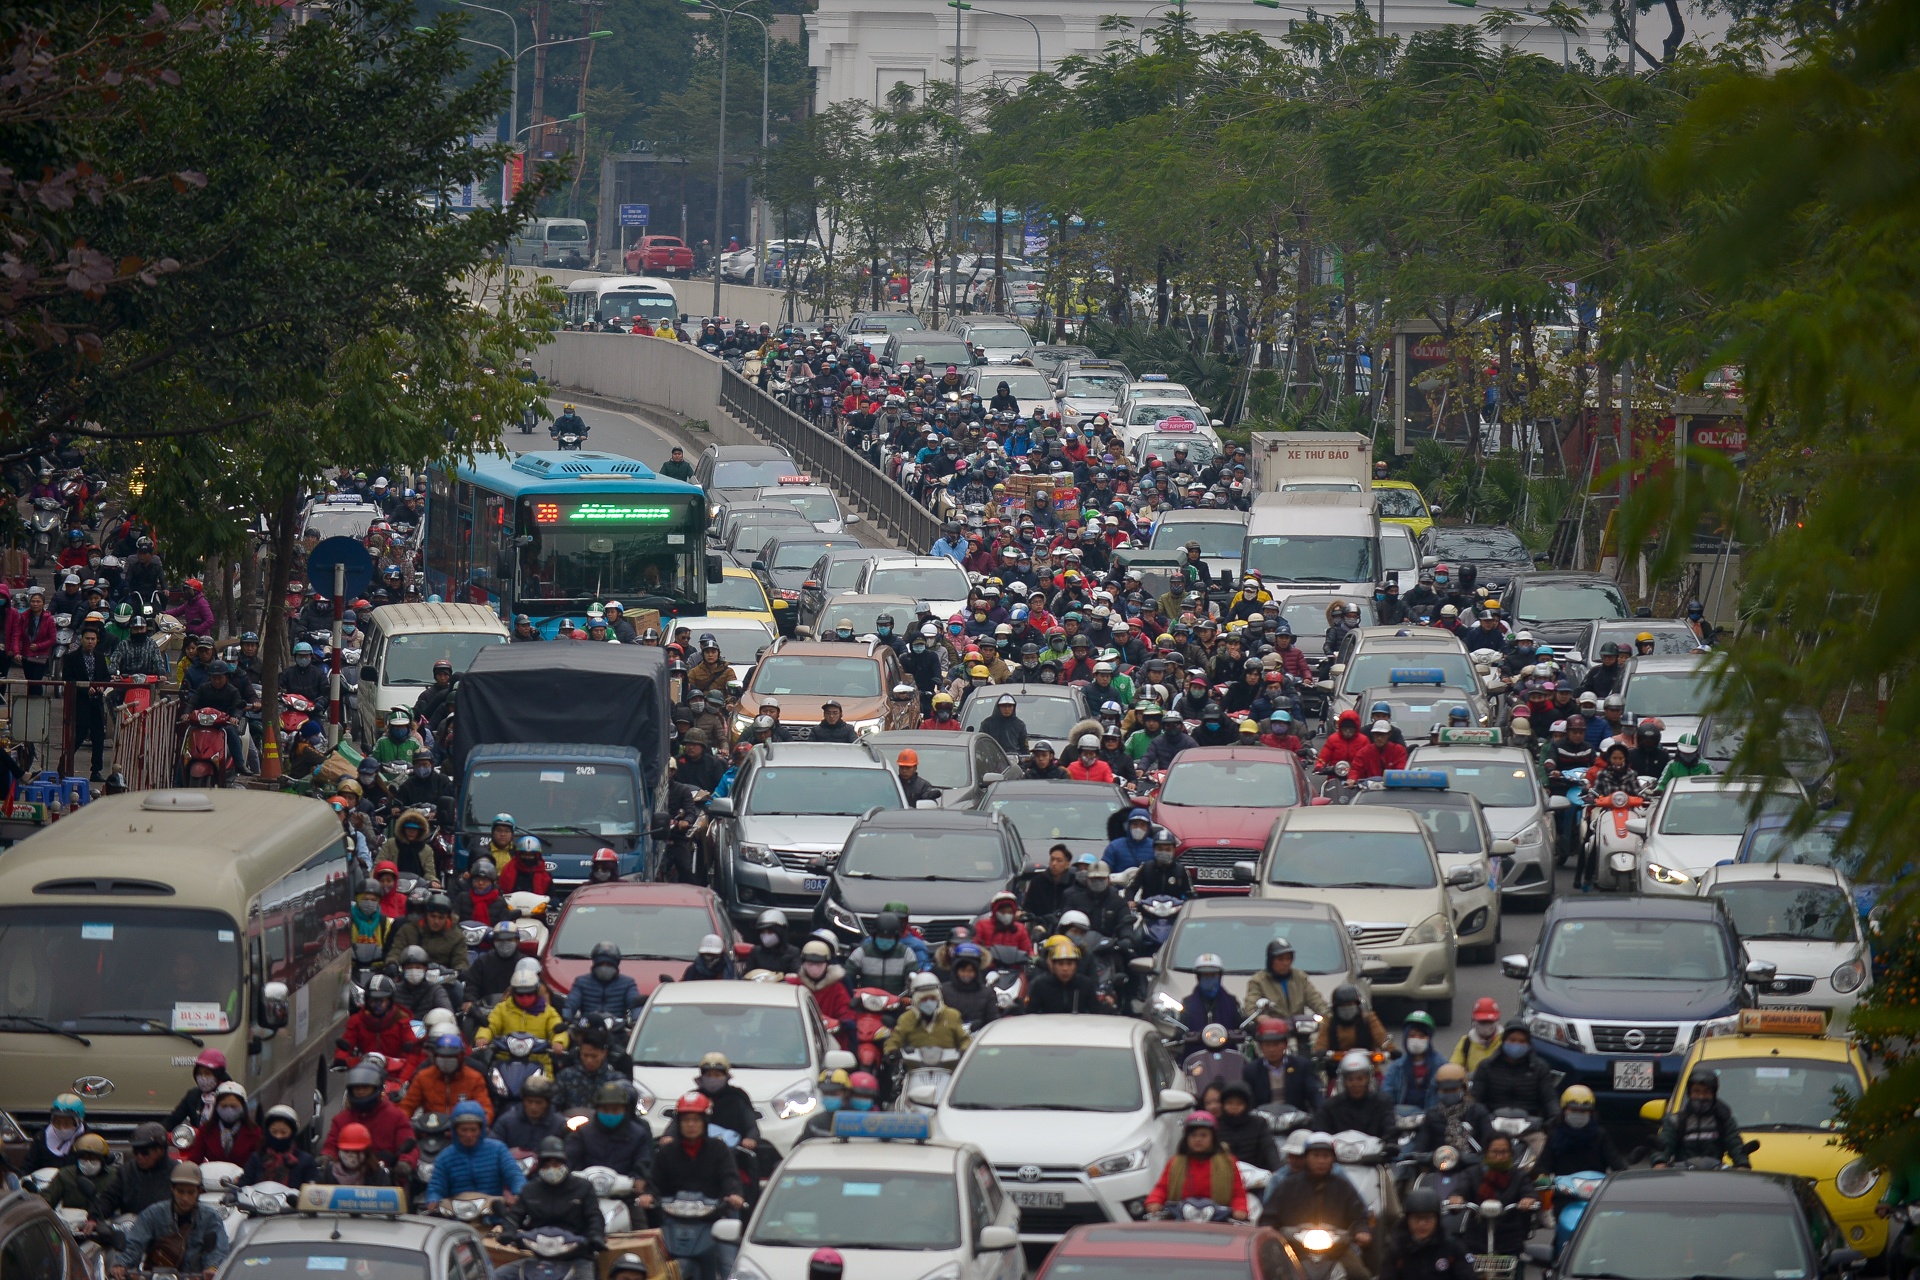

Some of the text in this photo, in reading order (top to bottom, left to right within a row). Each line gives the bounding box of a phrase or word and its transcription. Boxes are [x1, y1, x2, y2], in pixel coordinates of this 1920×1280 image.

[1413, 346, 1447, 357] OLYM
[1697, 431, 1747, 445] OLYMP
[1287, 450, 1301, 460] XE
[1305, 449, 1326, 460] THƯ
[180, 1011, 216, 1021] BUS 40
